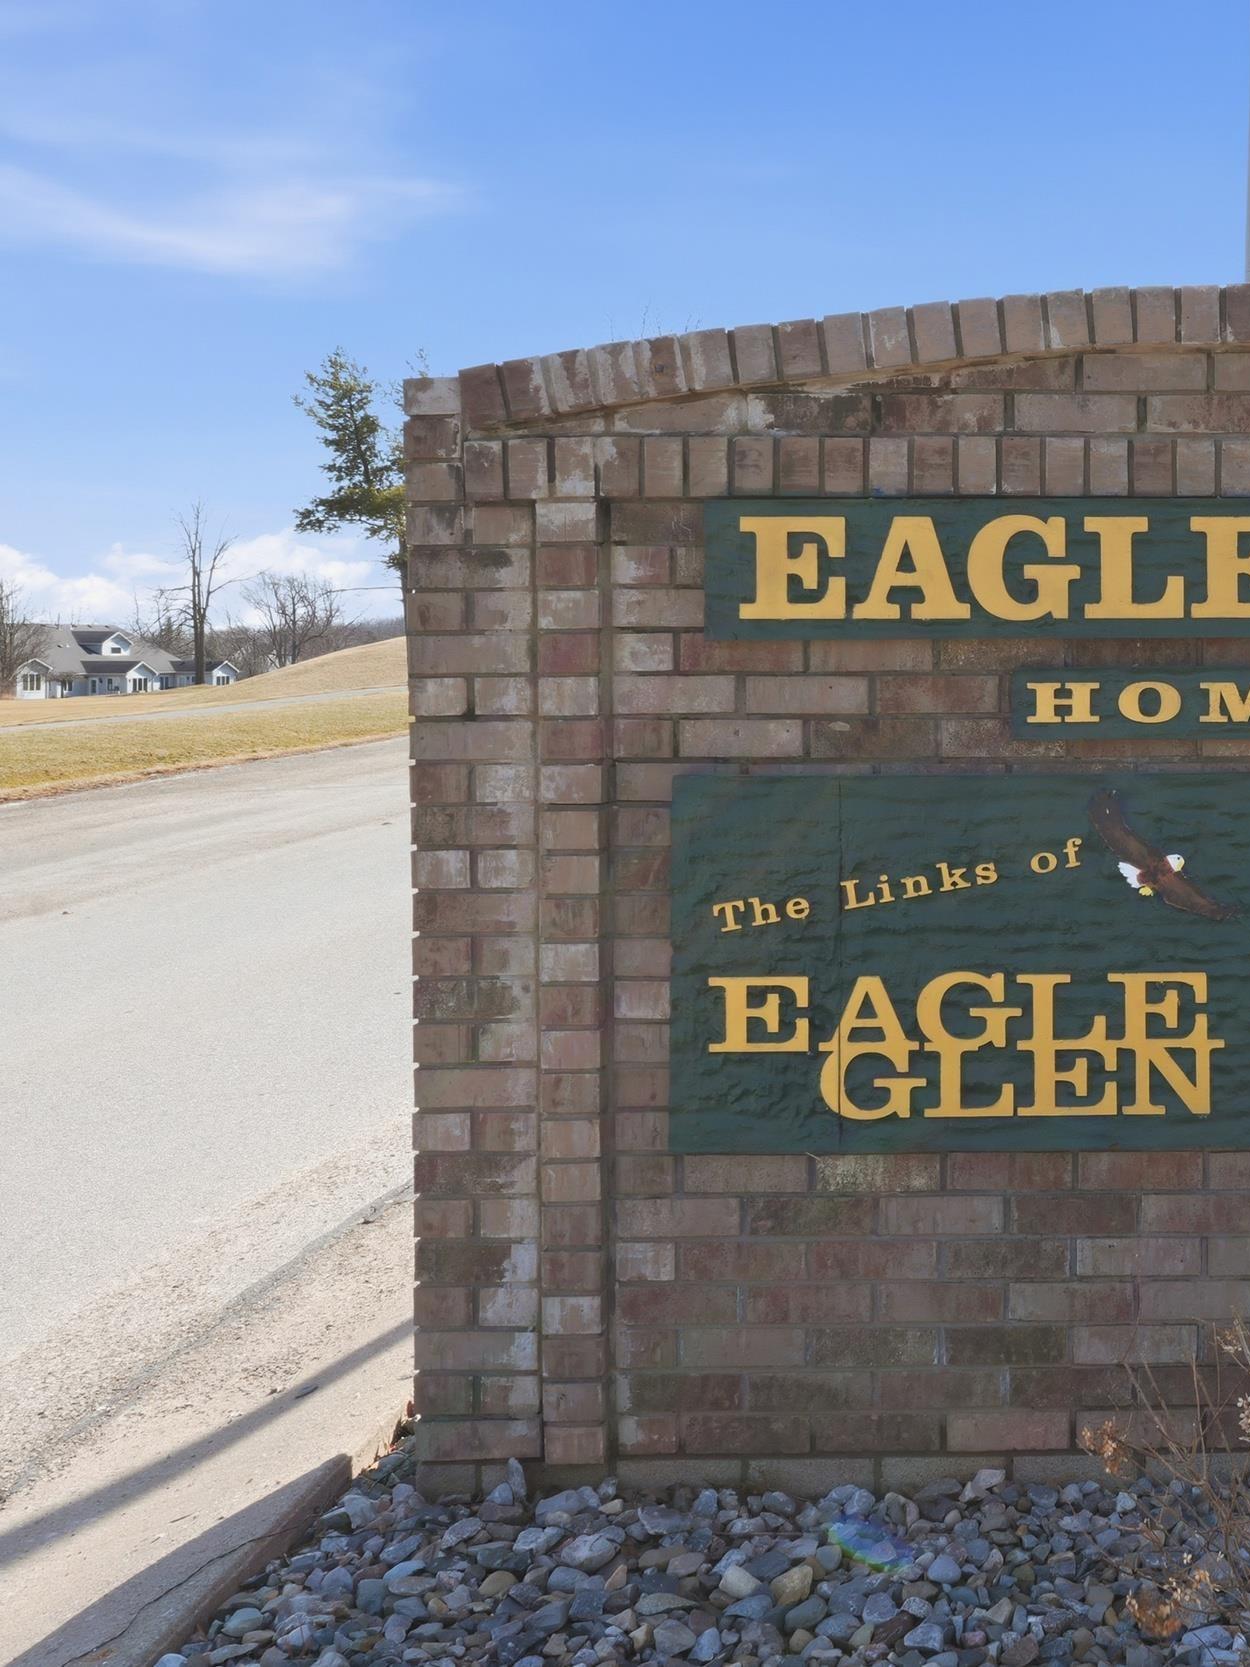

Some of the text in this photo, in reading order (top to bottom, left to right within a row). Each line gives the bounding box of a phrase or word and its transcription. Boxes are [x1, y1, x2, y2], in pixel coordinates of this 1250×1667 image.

[711, 837, 1083, 932] The Links of
[708, 971, 1210, 1053] EAGLE
[818, 1039, 1225, 1120] GLEN
